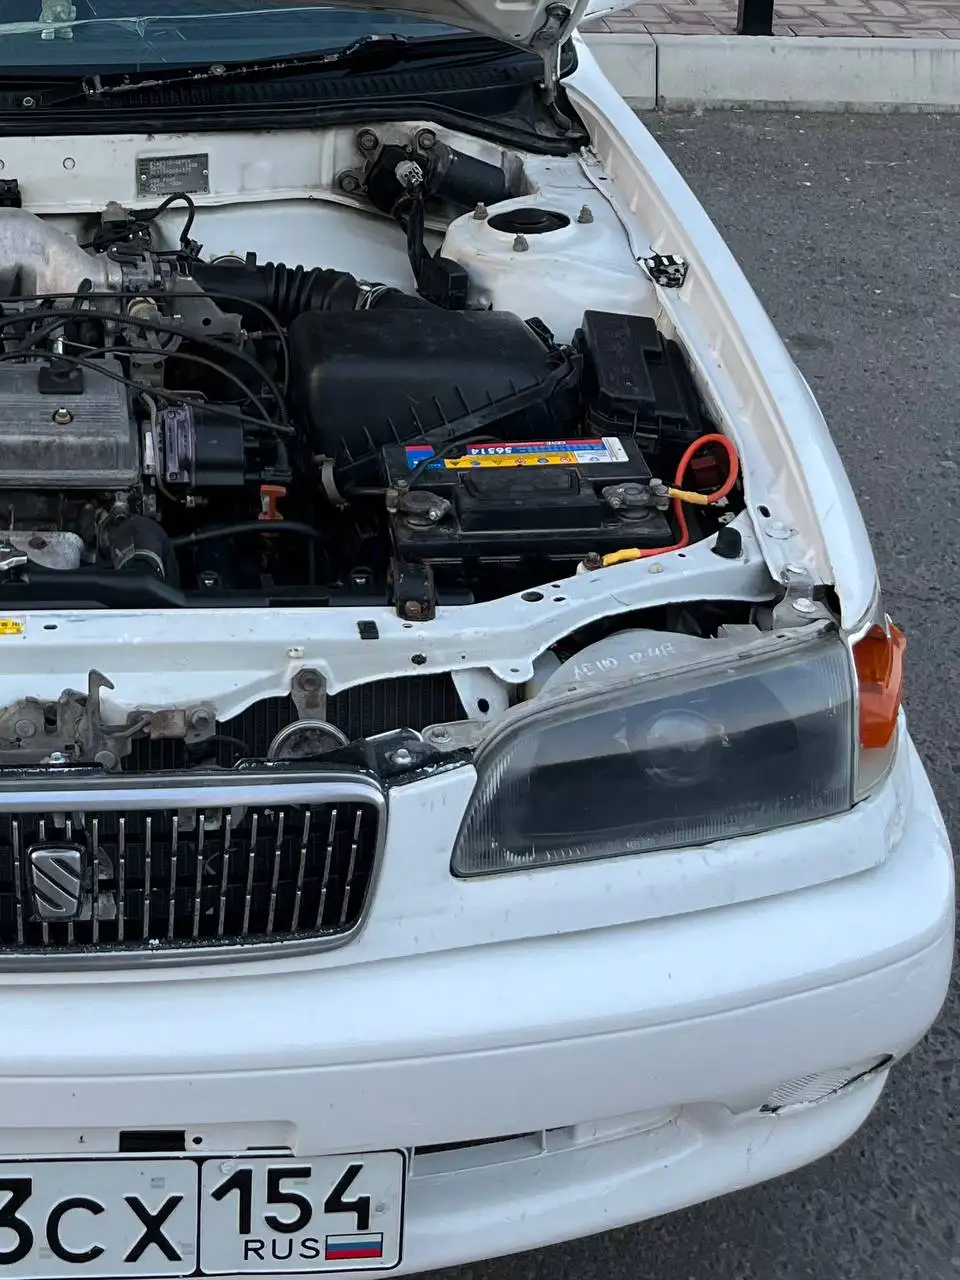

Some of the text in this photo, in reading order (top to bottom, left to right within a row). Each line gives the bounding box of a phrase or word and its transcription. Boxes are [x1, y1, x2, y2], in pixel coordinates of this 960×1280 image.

[471, 447, 512, 455] 56514
[210, 1163, 371, 1235] 154
[244, 1237, 321, 1261] RUS
